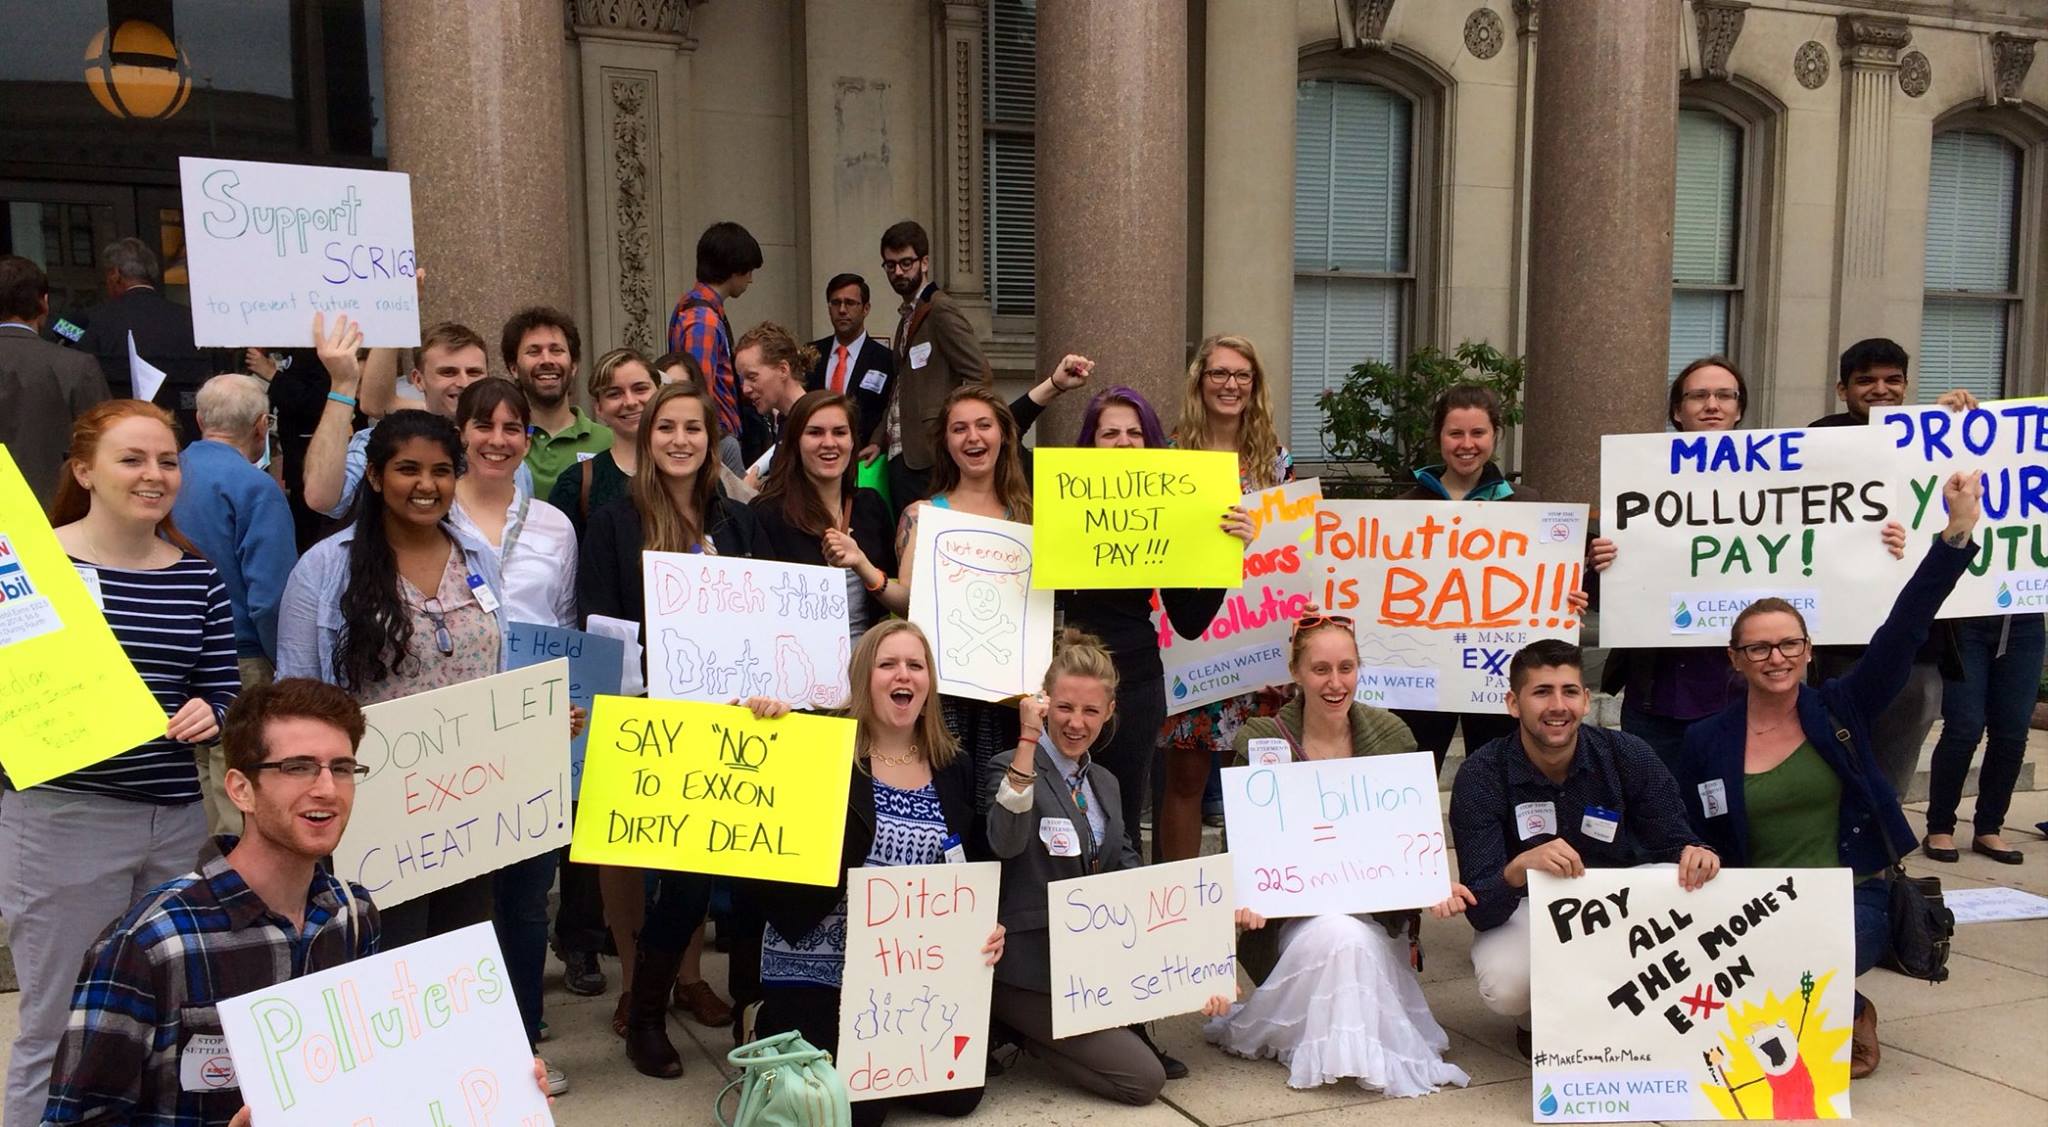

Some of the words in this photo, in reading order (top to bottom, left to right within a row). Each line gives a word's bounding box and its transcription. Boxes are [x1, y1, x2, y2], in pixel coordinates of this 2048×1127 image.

[202, 169, 362, 257] Support
[322, 241, 416, 285] SCR163
[207, 295, 231, 315] to
[240, 293, 296, 325] prevent
[308, 290, 361, 313] future
[1670, 431, 1806, 475] MAKE
[1056, 470, 1197, 500] POLLUTERS
[1616, 480, 1889, 530] POLLUTERS
[1910, 464, 2048, 531] YUR
[1085, 507, 1165, 534] MUST
[1315, 511, 1528, 562] Pollution
[946, 540, 971, 556] Not
[975, 546, 1024, 571] enough
[1690, 528, 1816, 578] PAY!
[654, 560, 766, 616] Ditch
[769, 571, 846, 621] this
[1201, 585, 1310, 642] ollutio
[1324, 567, 1360, 611] is
[532, 631, 583, 659] Held
[1478, 631, 1528, 644] MAKE
[661, 628, 773, 698] Dirty
[1188, 661, 1231, 681] CLEAN
[1234, 647, 1282, 667] WATER
[1191, 672, 1240, 695] ACTION
[1384, 676, 1436, 689] WATER
[491, 678, 563, 732] LET
[615, 718, 684, 757] SAY
[404, 754, 506, 815] EXXON
[632, 768, 661, 797] TO
[682, 770, 774, 808] EXXON
[1246, 769, 1285, 833] 9
[1315, 768, 1422, 822] billion
[358, 817, 479, 893] CHEAT
[495, 772, 565, 847] NJ!
[608, 809, 689, 847] DIRTY
[706, 819, 800, 857] DEAL
[866, 874, 976, 928] Ditch
[1254, 865, 1305, 893] 225
[1310, 860, 1395, 889] million
[1065, 888, 1137, 949] Say
[1146, 885, 1188, 930] NO
[1198, 867, 1223, 907] to
[1548, 887, 1631, 944] PAY
[875, 934, 945, 977] this
[1607, 949, 1692, 1017] THE
[1697, 876, 1798, 961] MONEY
[1628, 908, 1694, 959] ALL
[1064, 975, 1113, 1014] the
[1130, 942, 1238, 1002] settlement
[1663, 954, 1756, 1035] EXXON
[198, 1037, 224, 1045] STOP
[249, 957, 503, 1111] Polluters
[854, 985, 960, 1052] dirty
[1563, 1081, 1620, 1097] CLEAN
[1626, 1079, 1689, 1095] WATER
[1563, 1100, 1630, 1115] ACTION
